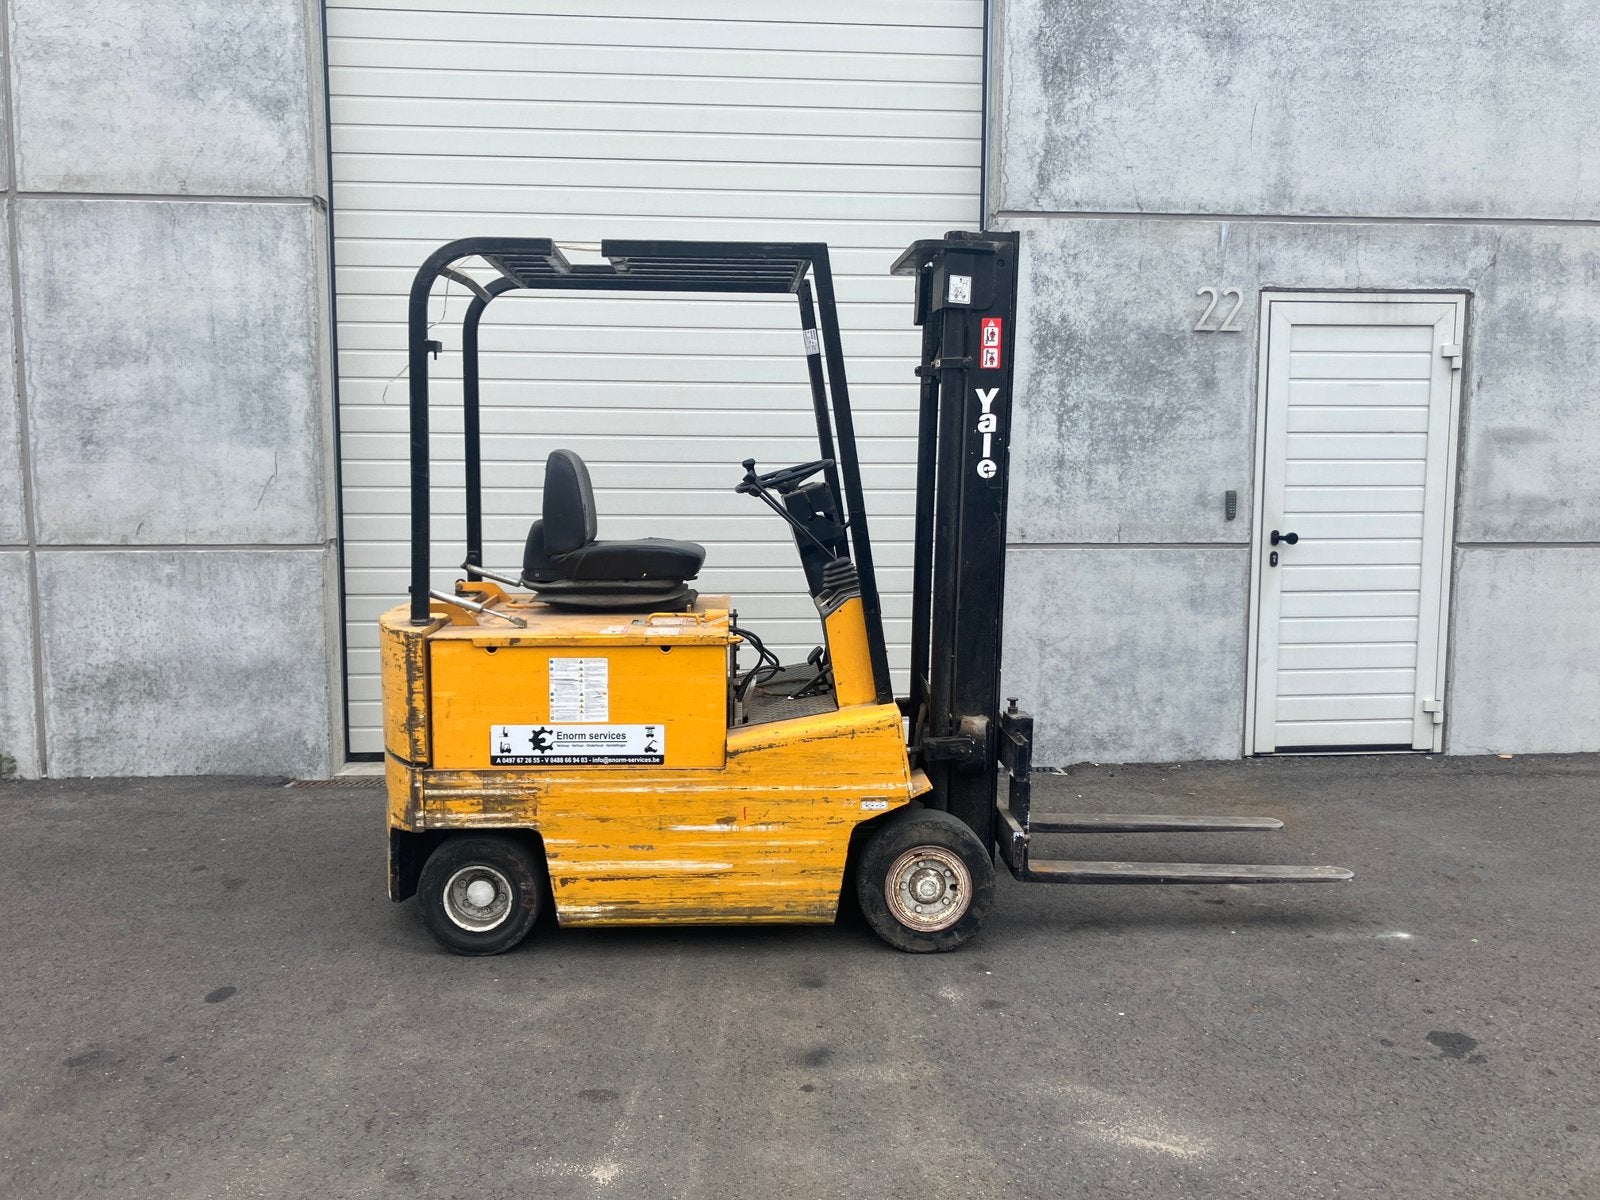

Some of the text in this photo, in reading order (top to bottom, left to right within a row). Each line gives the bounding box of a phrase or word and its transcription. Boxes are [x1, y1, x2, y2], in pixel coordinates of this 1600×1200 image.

[1194, 286, 1244, 331] 22
[975, 388, 999, 479] Yale
[556, 731, 626, 740] Enorm services
